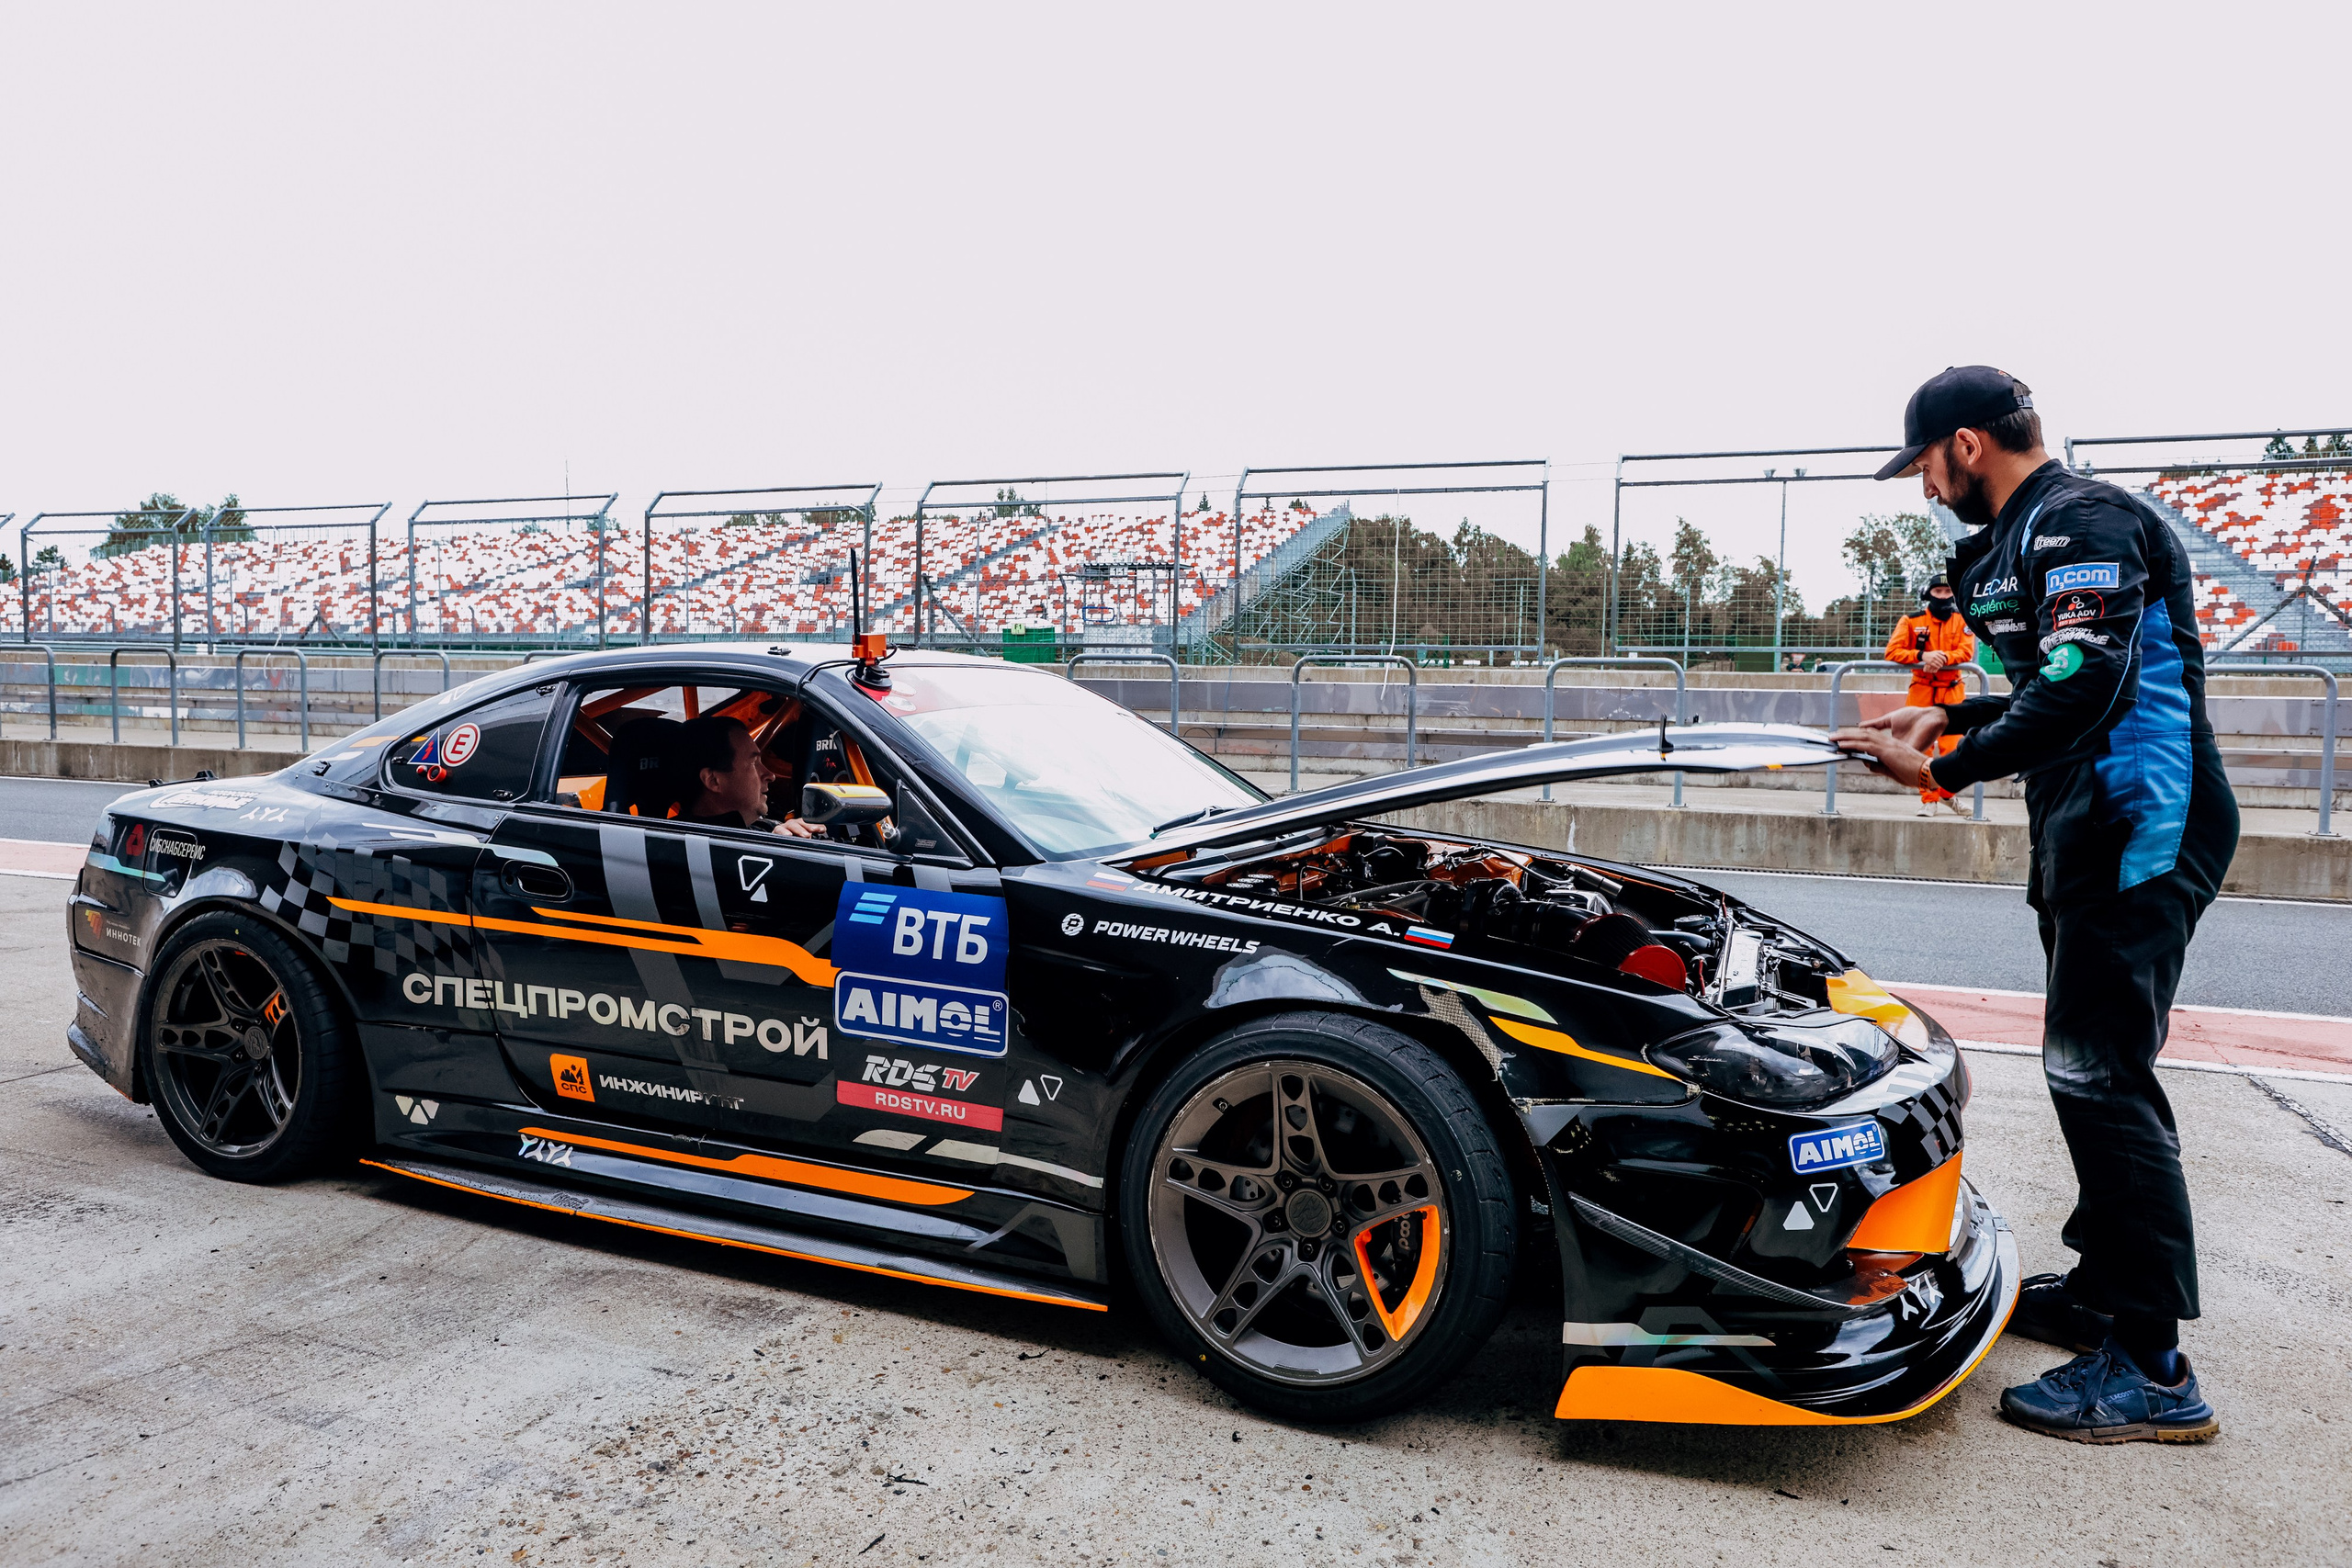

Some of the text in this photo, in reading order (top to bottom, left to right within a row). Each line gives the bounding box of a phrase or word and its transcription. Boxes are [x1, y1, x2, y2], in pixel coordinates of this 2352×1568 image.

[1972, 576, 2018, 598] LECAR
[2057, 609, 2097, 621] YUKA ADV
[450, 733, 470, 755] E
[1134, 881, 1361, 927] ДМИТРИЕНКО
[106, 927, 141, 948] ИННОТЕК
[892, 907, 991, 964] ВТБ
[401, 971, 829, 1060] СПЕЦПРОМСТРОЙ
[560, 1082, 587, 1094] СПС
[875, 1091, 967, 1120] RDSTV.RU
[1798, 1130, 1882, 1166] AIMOL
